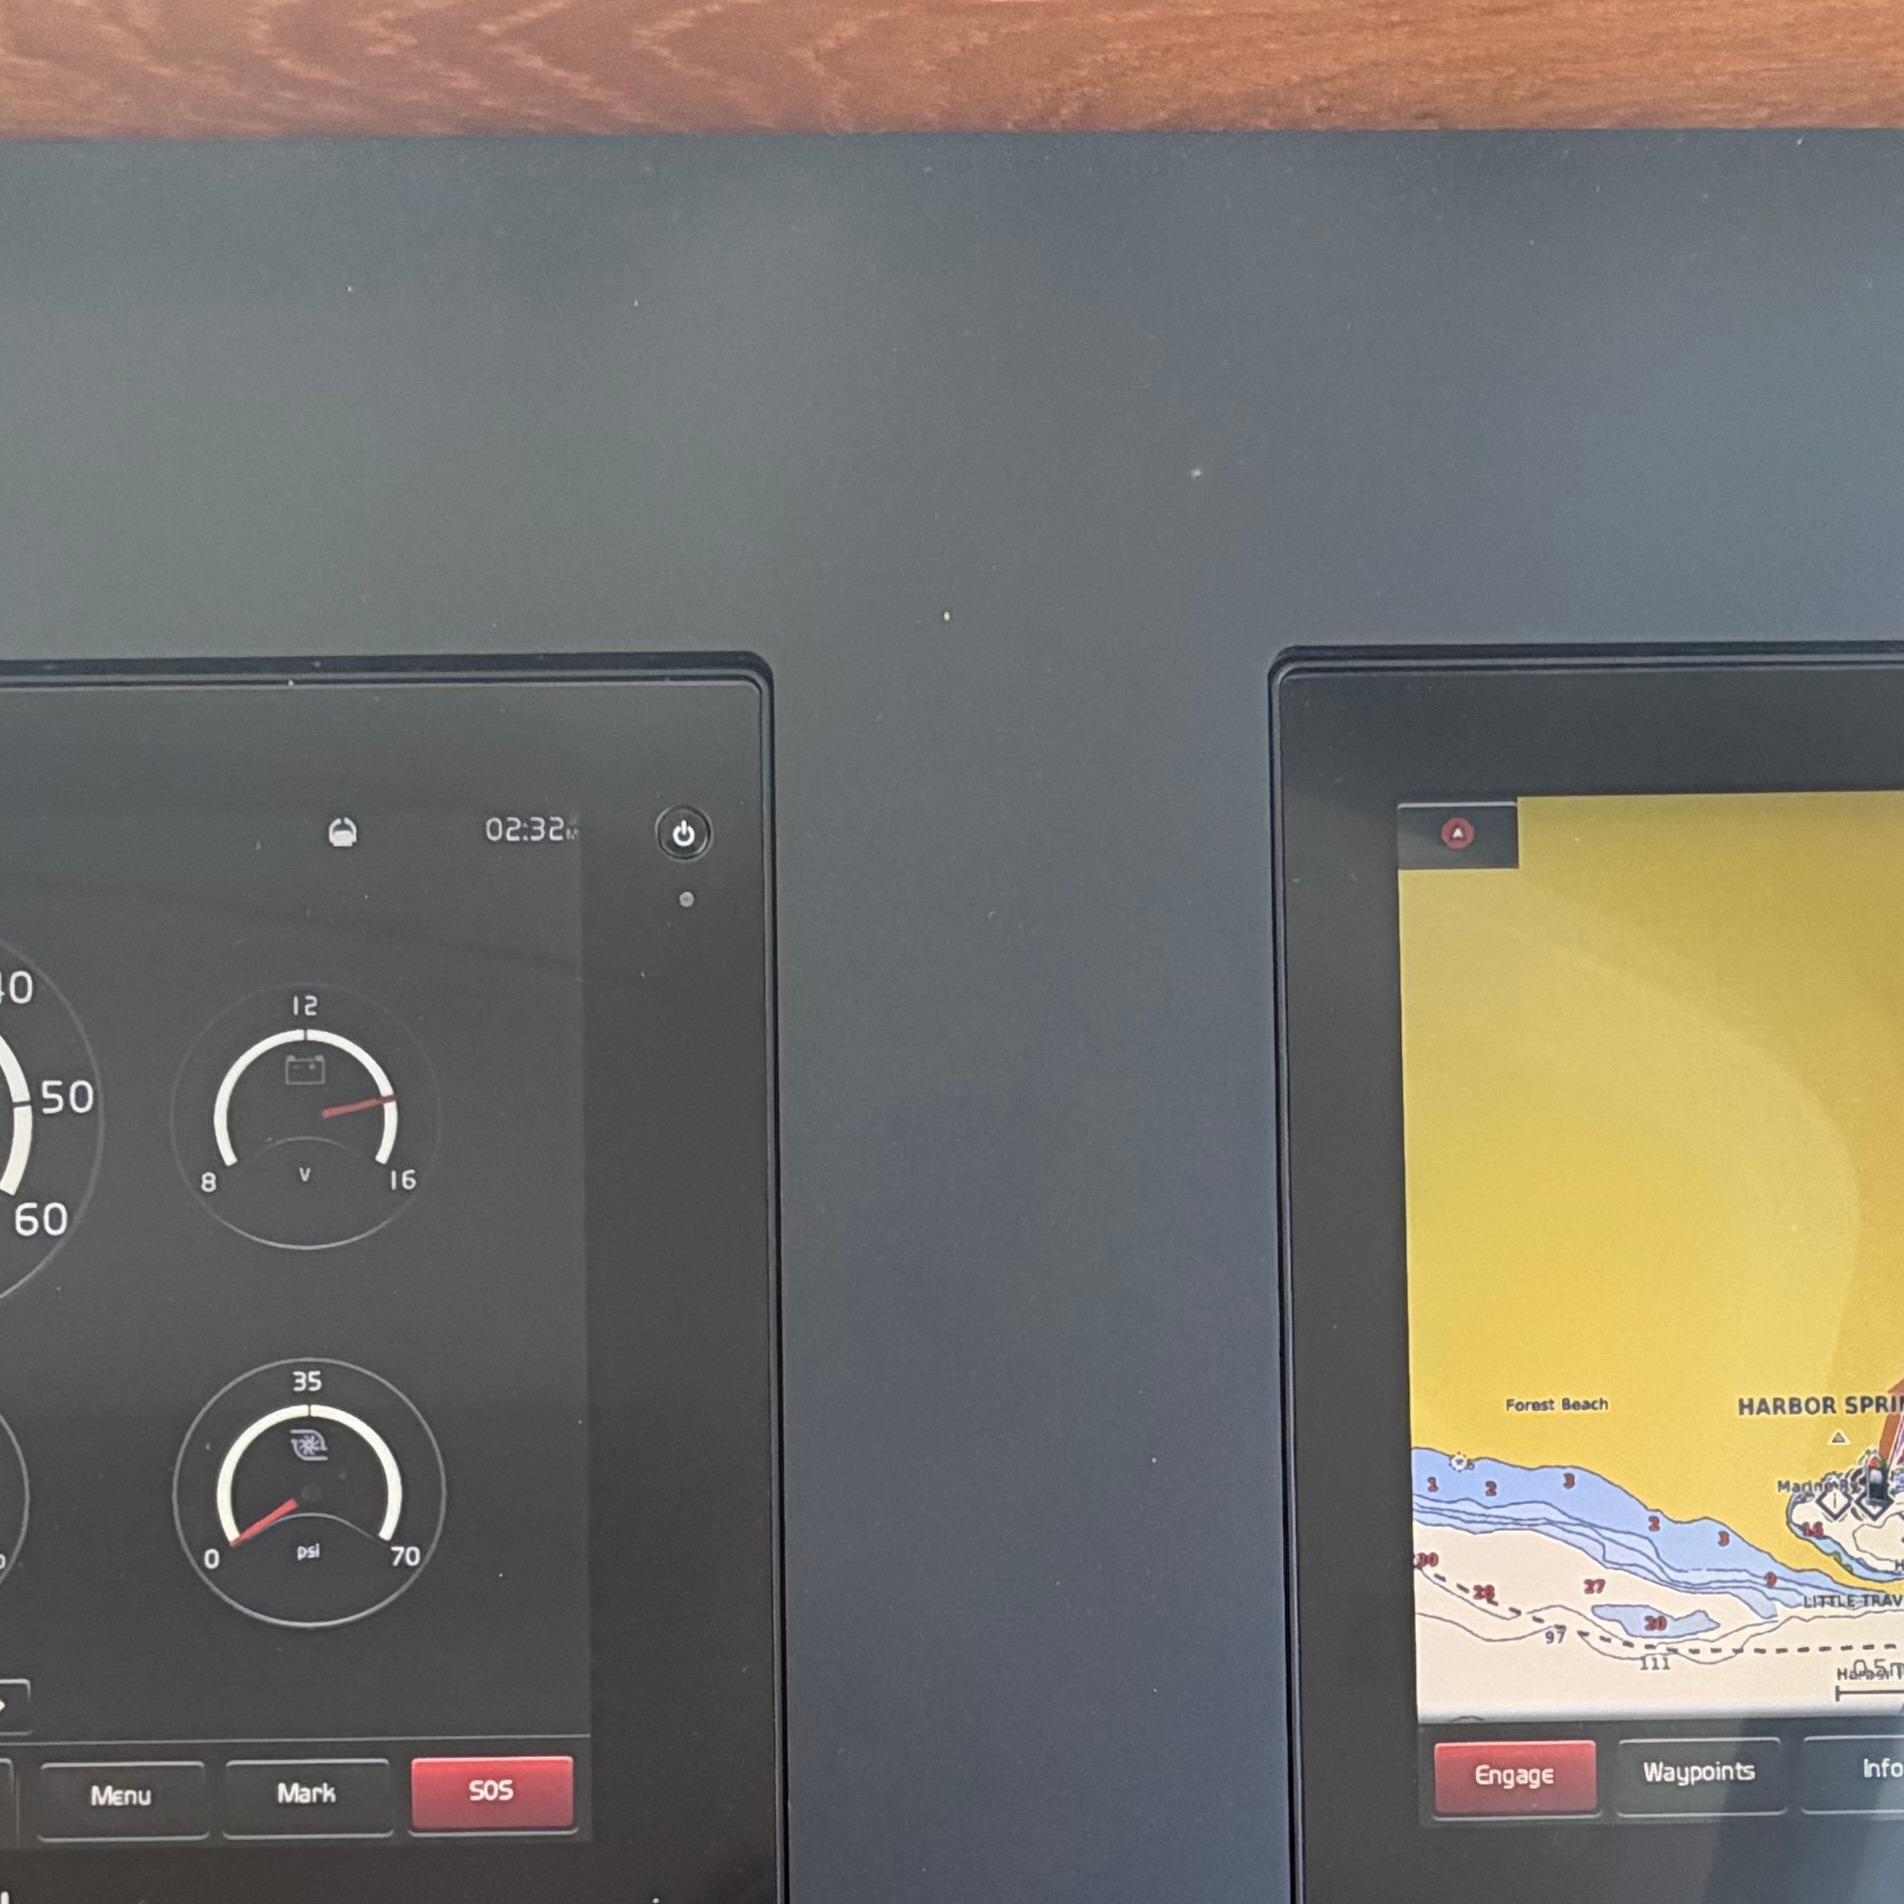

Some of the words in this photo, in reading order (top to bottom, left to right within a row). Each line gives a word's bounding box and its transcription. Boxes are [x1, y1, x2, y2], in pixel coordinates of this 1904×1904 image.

[293, 996, 317, 1016] 12
[41, 1080, 94, 1113] 50
[201, 1173, 217, 1193] 8
[390, 1170, 416, 1190] 16
[14, 1202, 68, 1236] 60
[292, 1370, 323, 1392] 35
[1506, 1399, 1555, 1412] Forest
[1562, 1397, 1609, 1411] Beach
[1738, 1396, 1837, 1416] HARBOR
[204, 1548, 220, 1569] 0
[297, 1544, 321, 1560] psi
[391, 1546, 421, 1567] 70
[1545, 1630, 1566, 1644] 97
[1475, 1764, 1554, 1789] Engage
[1643, 1760, 1756, 1786] Waypoints
[1863, 1758, 1904, 1779] Info
[90, 1785, 152, 1807] Menu
[277, 1782, 336, 1806] Mark
[469, 1780, 514, 1801] SOS
